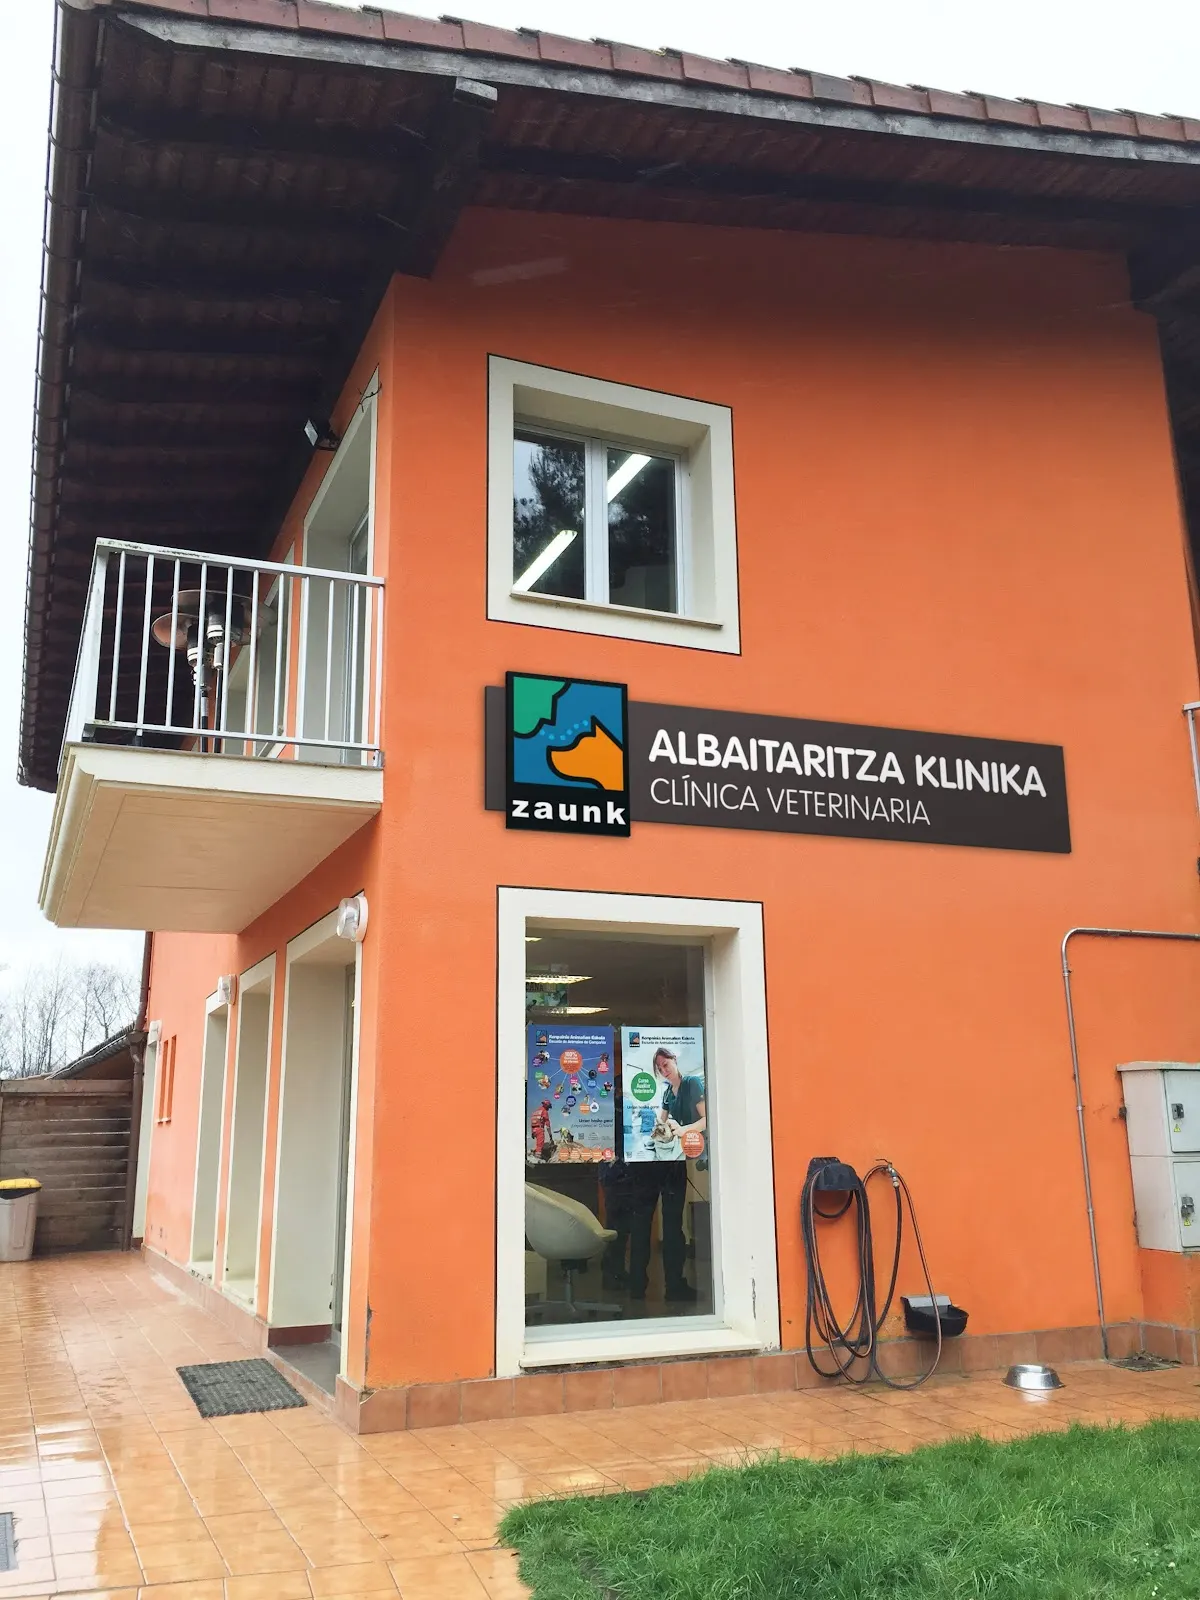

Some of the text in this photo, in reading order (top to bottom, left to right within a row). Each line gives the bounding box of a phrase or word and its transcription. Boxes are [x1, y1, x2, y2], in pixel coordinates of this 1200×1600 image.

[649, 729, 1047, 797] ALBAITARITZA KLINIKA
[512, 799, 626, 825] zaunk
[650, 774, 931, 825] CLÍNICA VETERINARIA
